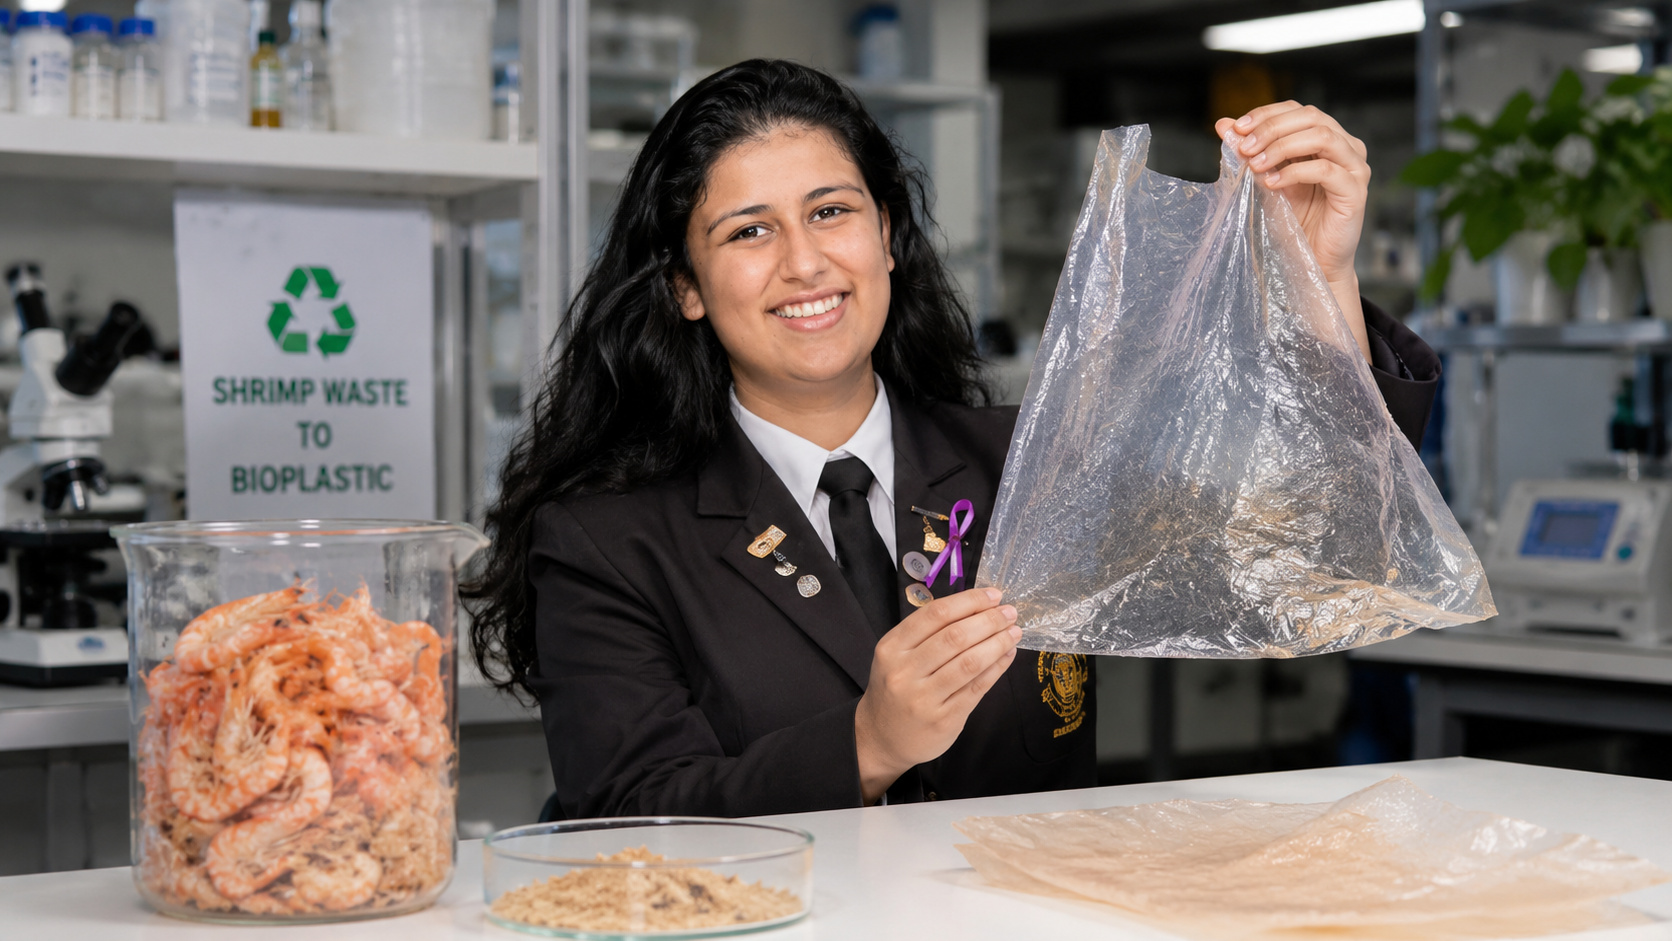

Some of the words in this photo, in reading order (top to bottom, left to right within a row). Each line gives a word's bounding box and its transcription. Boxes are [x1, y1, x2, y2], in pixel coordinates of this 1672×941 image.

[213, 377, 315, 405] SHRIMP
[323, 379, 407, 406] WASTE
[297, 421, 332, 448] TO
[231, 465, 393, 493] BIOPLASTIC
